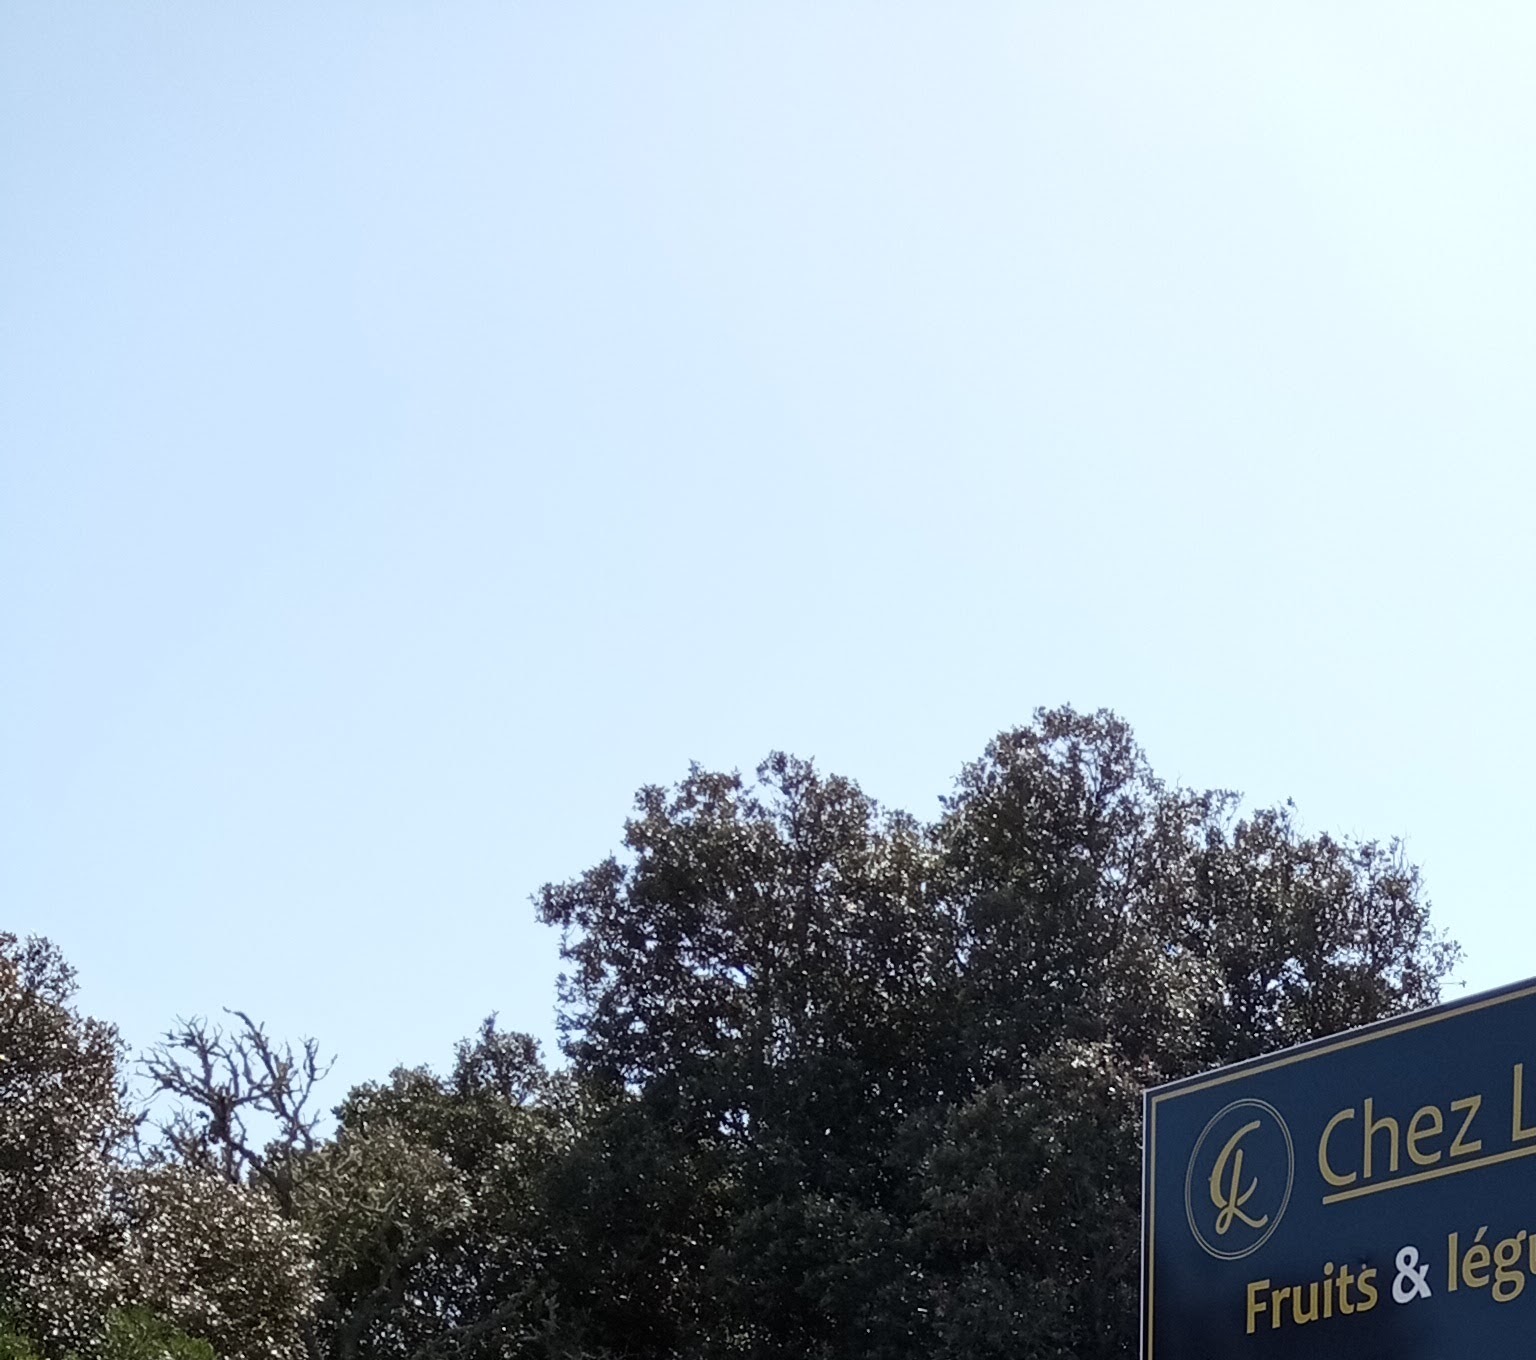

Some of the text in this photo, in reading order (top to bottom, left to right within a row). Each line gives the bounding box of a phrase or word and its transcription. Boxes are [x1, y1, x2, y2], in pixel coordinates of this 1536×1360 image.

[1318, 1094, 1483, 1187] Chez
[1245, 1262, 1378, 1334] Fruits
[1391, 1246, 1432, 1304] &
